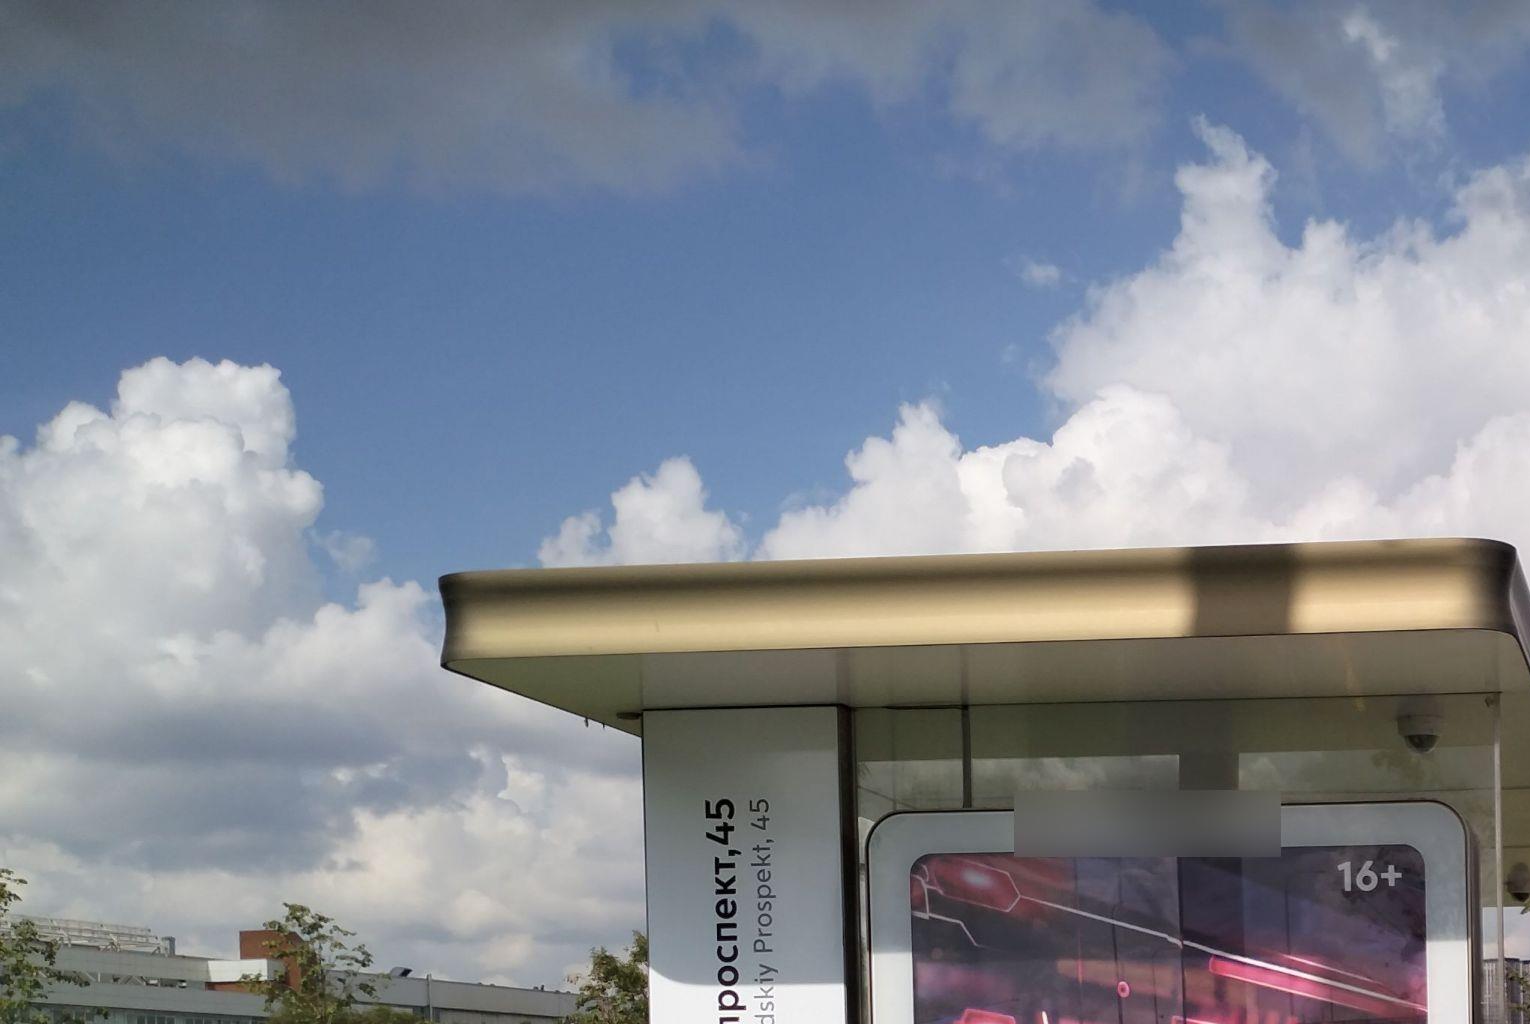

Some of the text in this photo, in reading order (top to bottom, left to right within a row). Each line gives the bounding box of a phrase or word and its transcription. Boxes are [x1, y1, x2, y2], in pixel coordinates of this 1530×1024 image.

[749, 798, 770, 831] 45
[1336, 860, 1403, 892] 16+
[750, 838, 776, 953] Prospekt,
